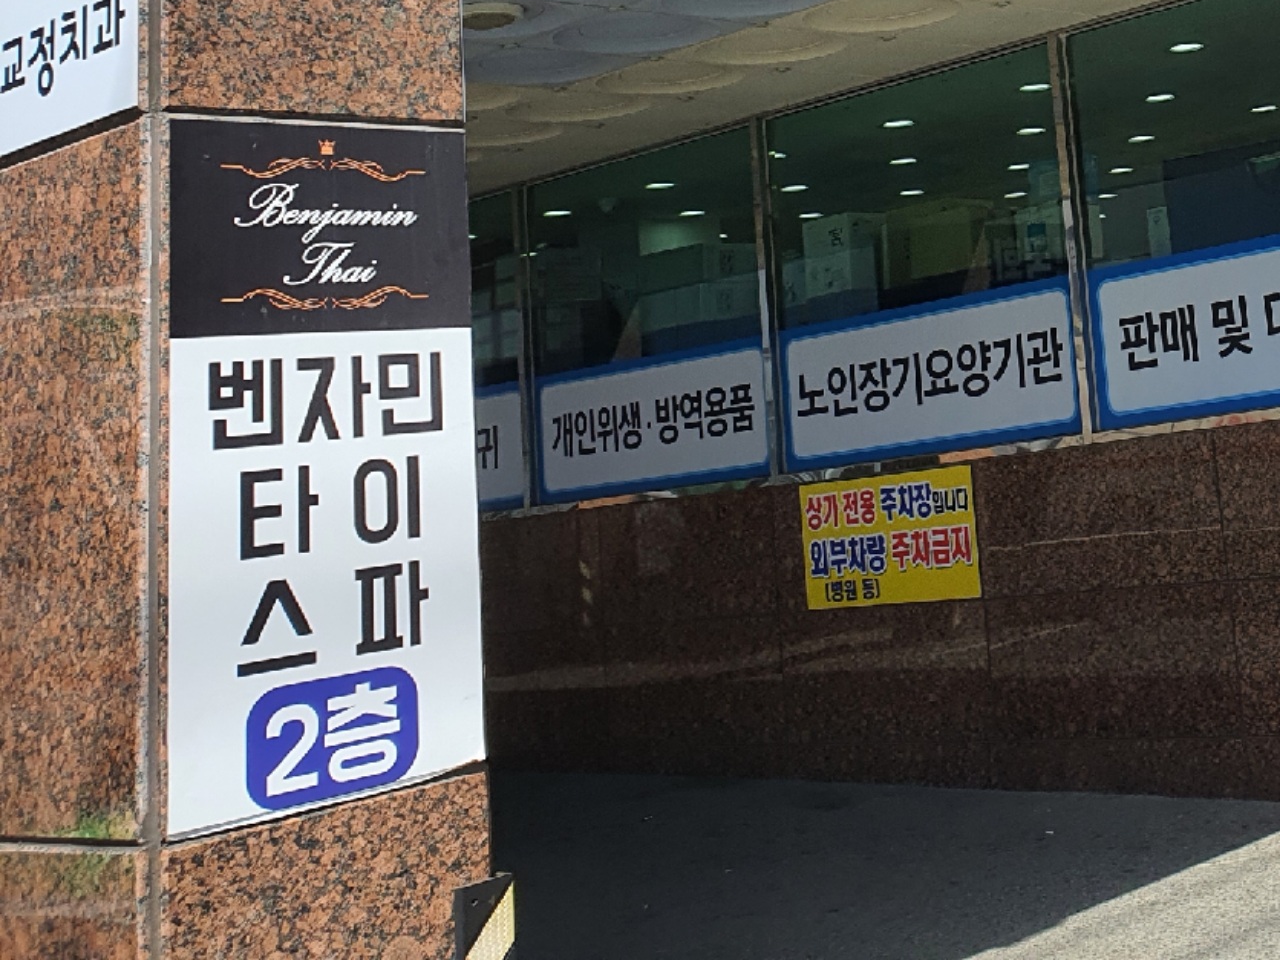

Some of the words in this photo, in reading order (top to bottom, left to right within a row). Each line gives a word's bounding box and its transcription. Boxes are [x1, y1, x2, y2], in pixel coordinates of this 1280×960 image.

[233, 183, 418, 242] Benjamin
[282, 242, 377, 287] Thai
[796, 327, 1063, 418] 노인장기요양기관
[1119, 305, 1199, 371] 판매
[1211, 295, 1253, 359] 및
[208, 352, 443, 451] 벤자민
[240, 455, 420, 561] 타이
[806, 494, 838, 530] 상가
[842, 488, 875, 526] 전용
[811, 534, 886, 577] 외부차량
[891, 526, 973, 570] 주차금지
[237, 560, 429, 677] 스파
[265, 680, 401, 799] 2층
